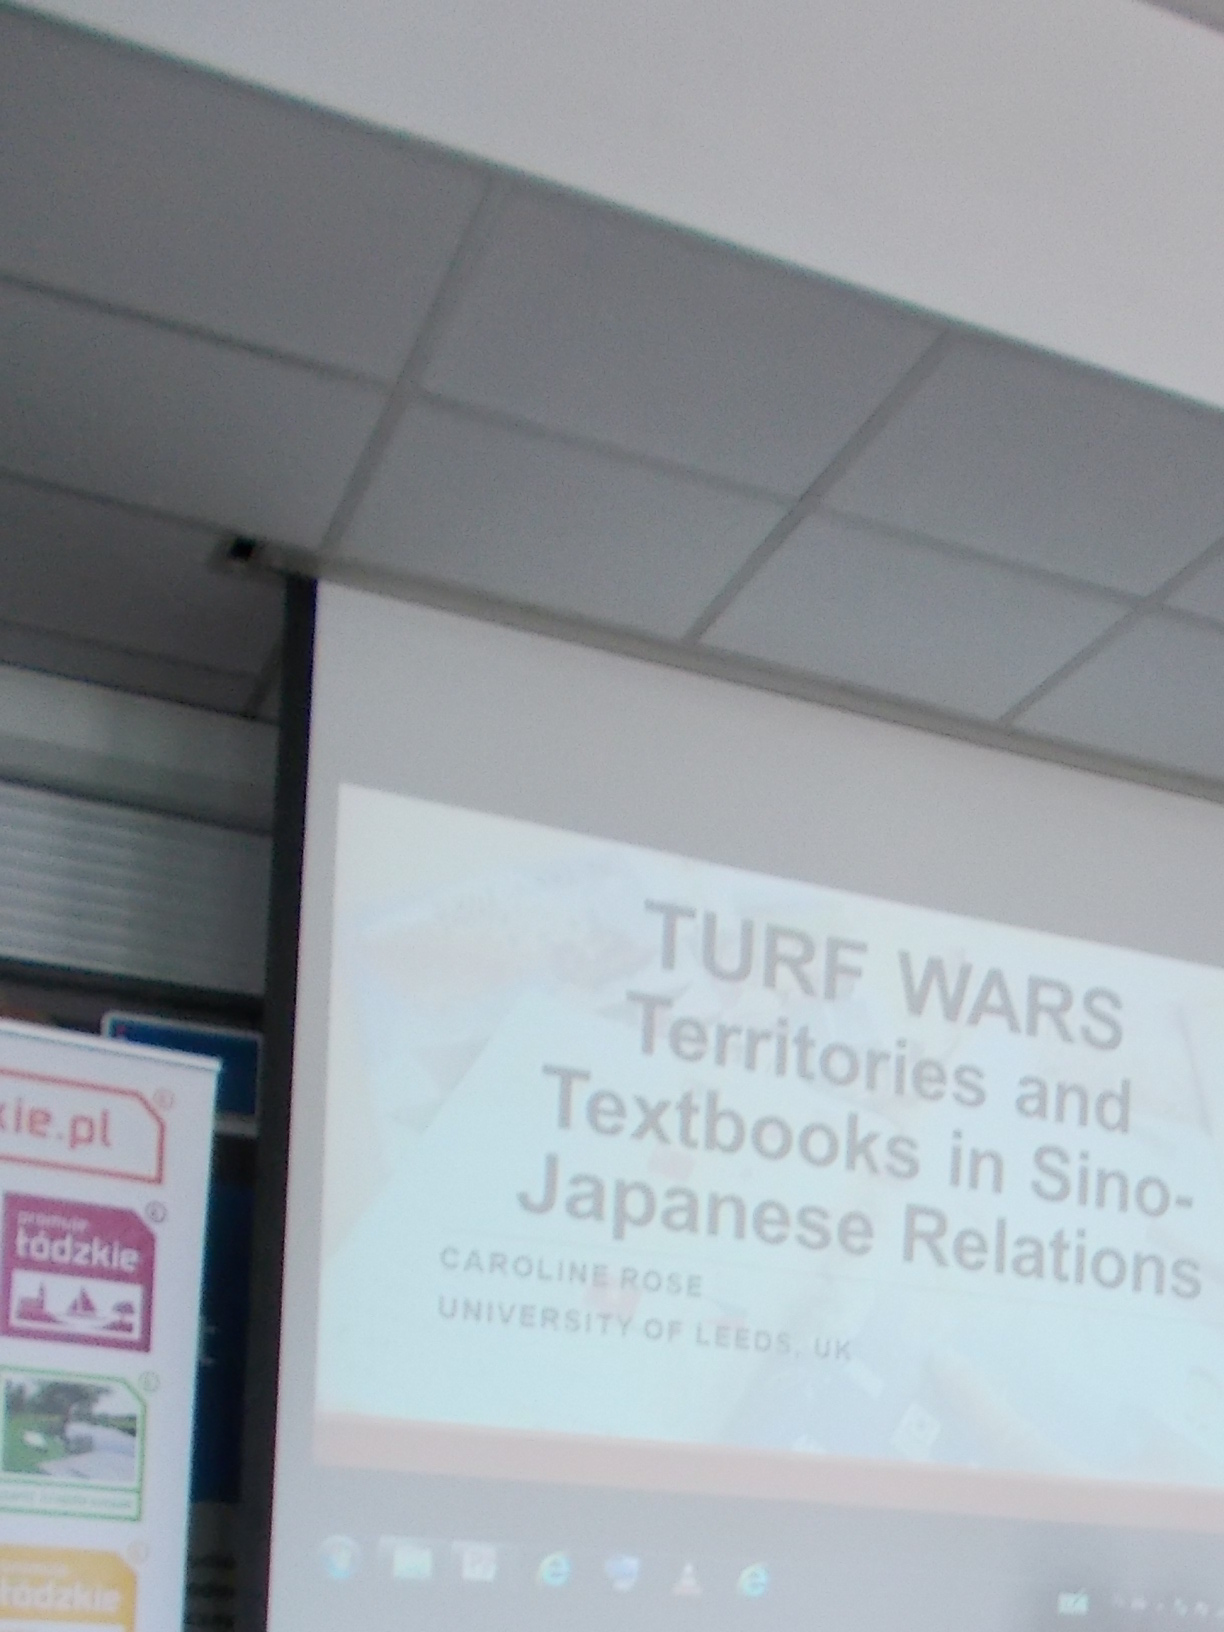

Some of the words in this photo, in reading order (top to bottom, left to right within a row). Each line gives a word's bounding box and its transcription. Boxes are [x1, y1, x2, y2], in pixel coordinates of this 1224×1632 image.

[644, 898, 868, 1001] TURF
[897, 947, 1125, 1052] WARS
[626, 989, 987, 1107] Territories
[1015, 1075, 1131, 1135] and
[542, 1063, 921, 1181] Textbooks
[949, 1130, 1004, 1194] in
[1030, 1143, 1195, 1218] Sino-
[16, 1226, 140, 1274] łódzkie
[439, 1246, 609, 1288] CAROLINE
[619, 1266, 702, 1299] ROSE
[516, 1153, 875, 1256] Japanese
[902, 1203, 1202, 1300] Relations
[437, 1295, 633, 1338] UNIVERSITY
[642, 1317, 682, 1343] OF
[695, 1321, 801, 1360] LEEDS,
[812, 1338, 852, 1361] UK
